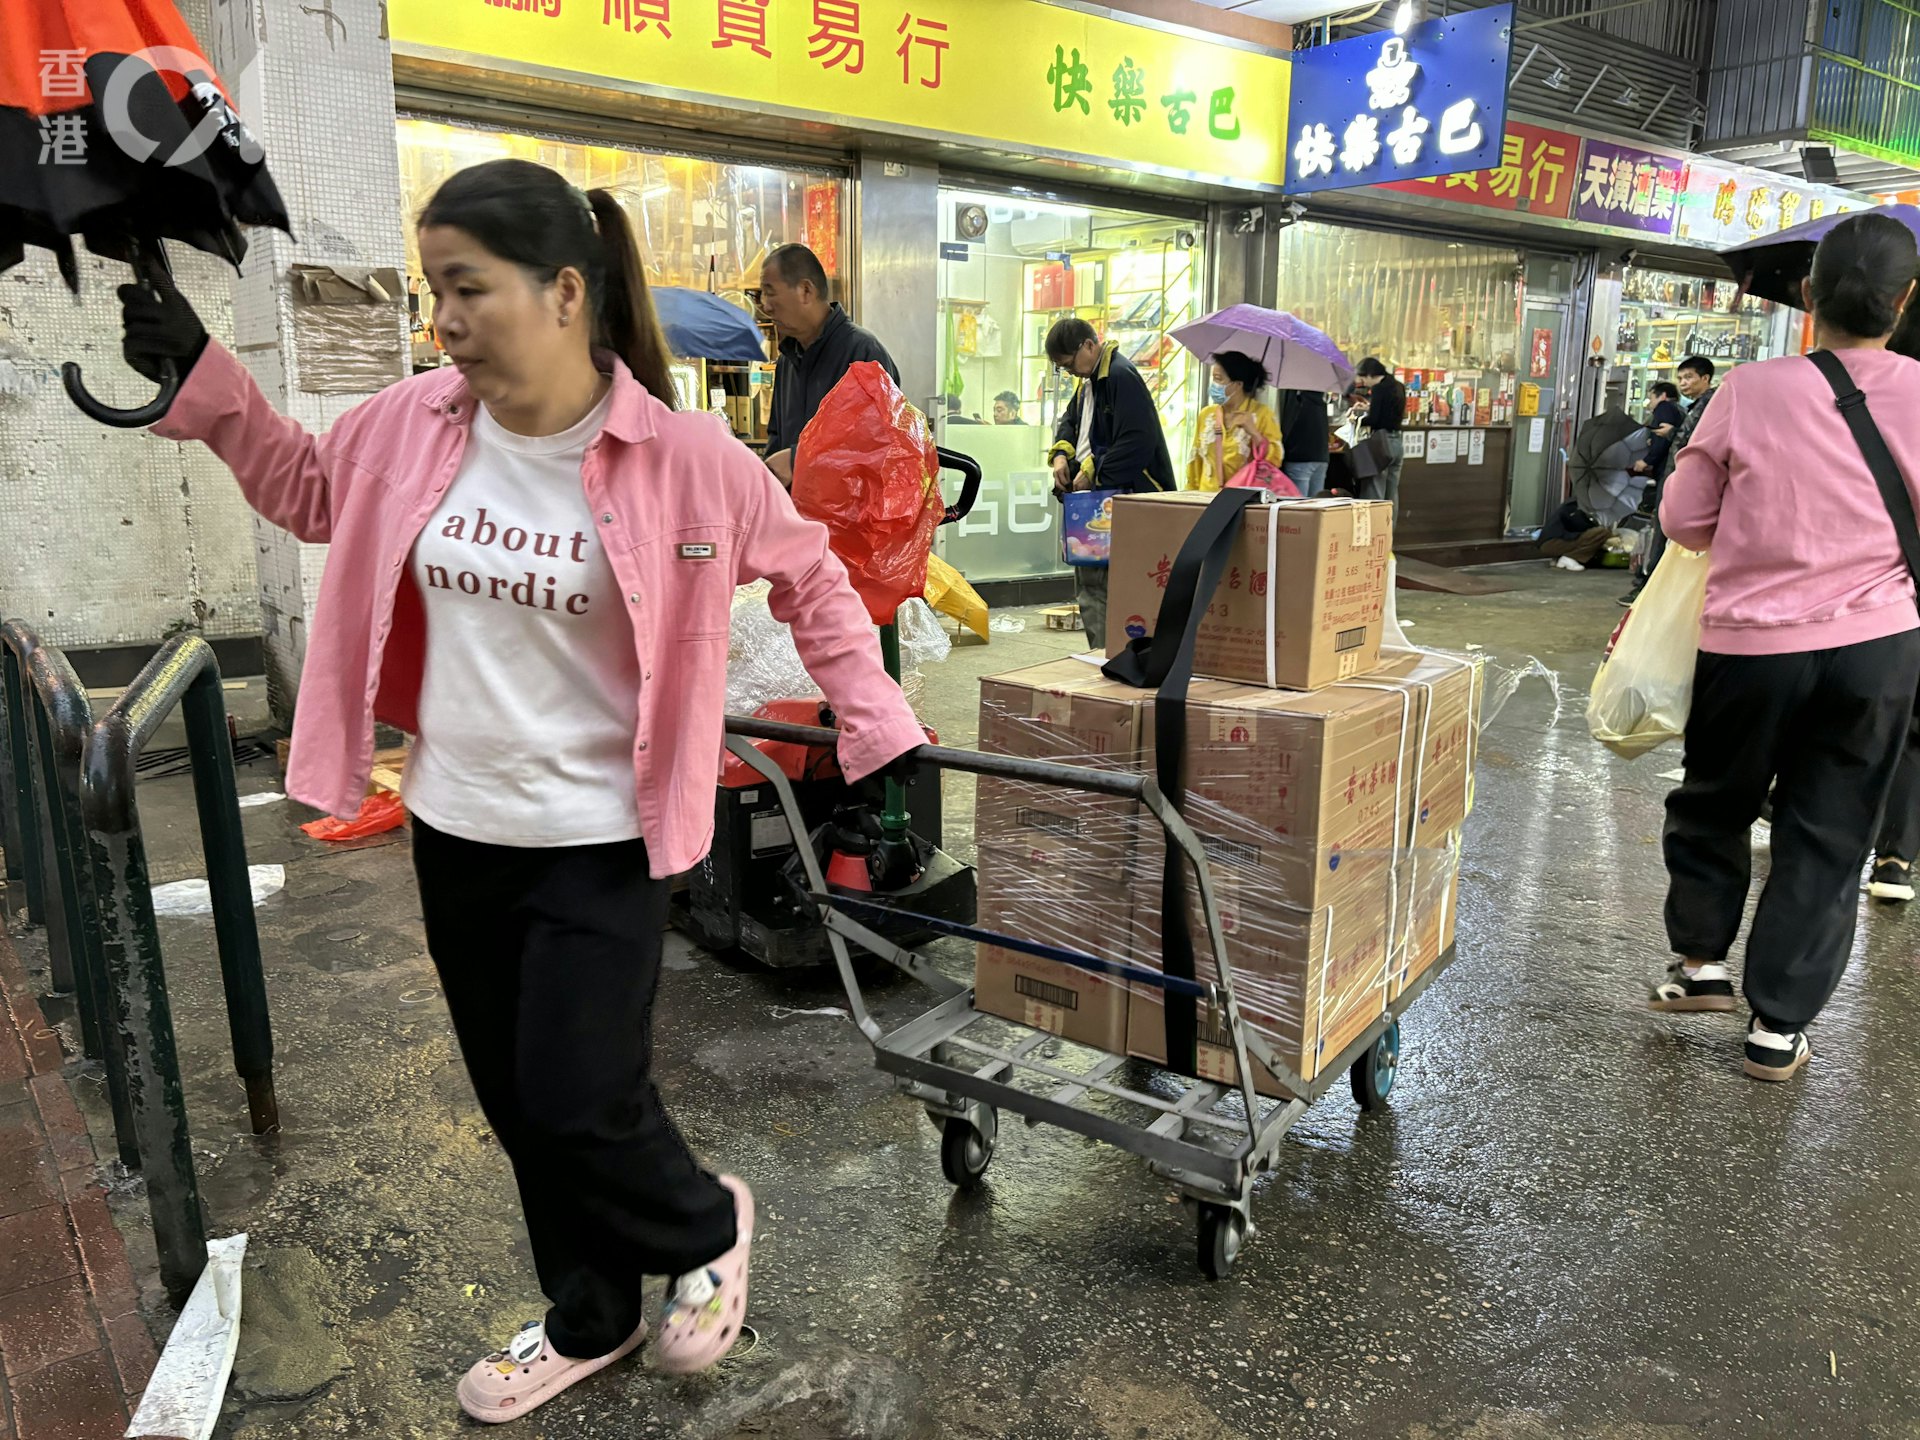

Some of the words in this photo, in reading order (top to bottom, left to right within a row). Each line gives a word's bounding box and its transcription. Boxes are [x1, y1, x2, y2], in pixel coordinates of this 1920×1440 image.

[485, 0, 950, 89] 貿易行
[1047, 44, 1240, 140] 快樂古巴
[441, 507, 588, 563] about
[424, 563, 590, 615] nordic
[1345, 565, 1359, 577] 5.65
